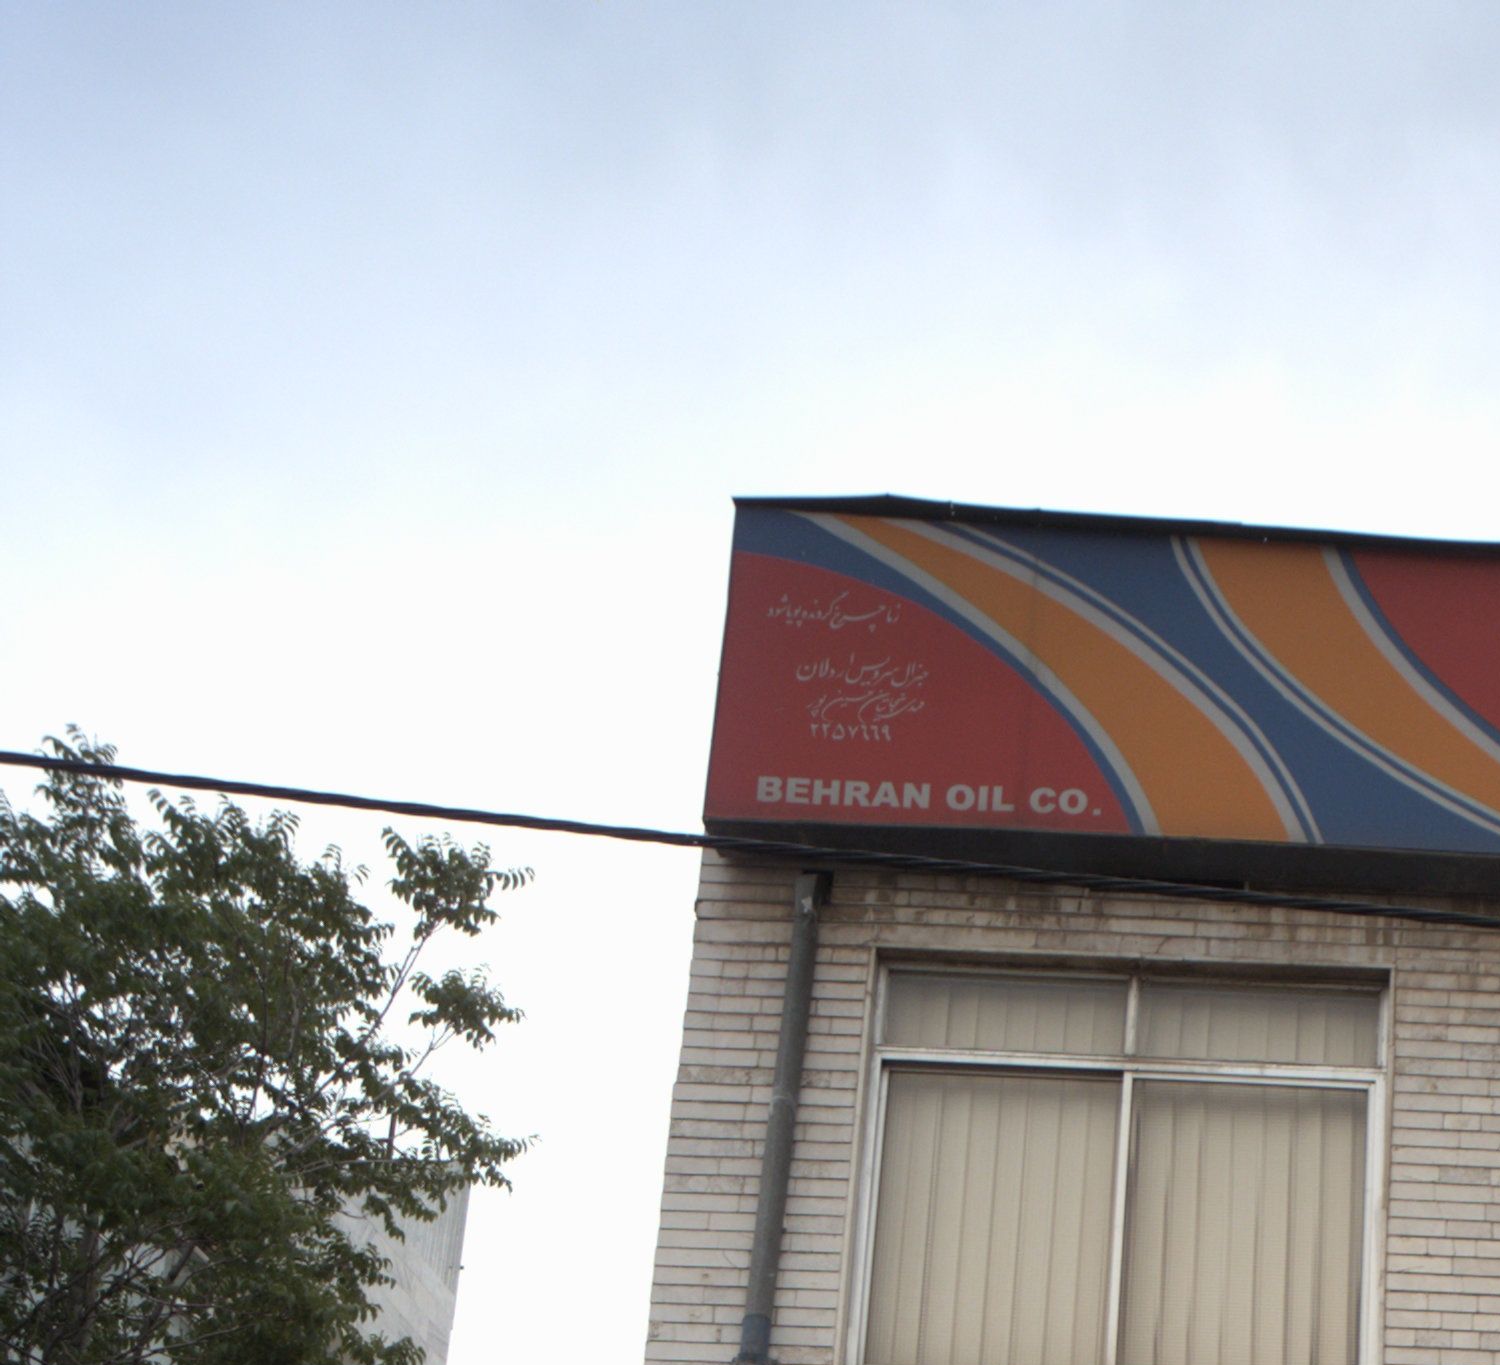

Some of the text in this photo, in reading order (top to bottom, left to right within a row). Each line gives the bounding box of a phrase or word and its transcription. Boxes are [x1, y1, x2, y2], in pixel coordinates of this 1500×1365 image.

[755, 775, 1102, 816] BEHRAN OIL CO.
